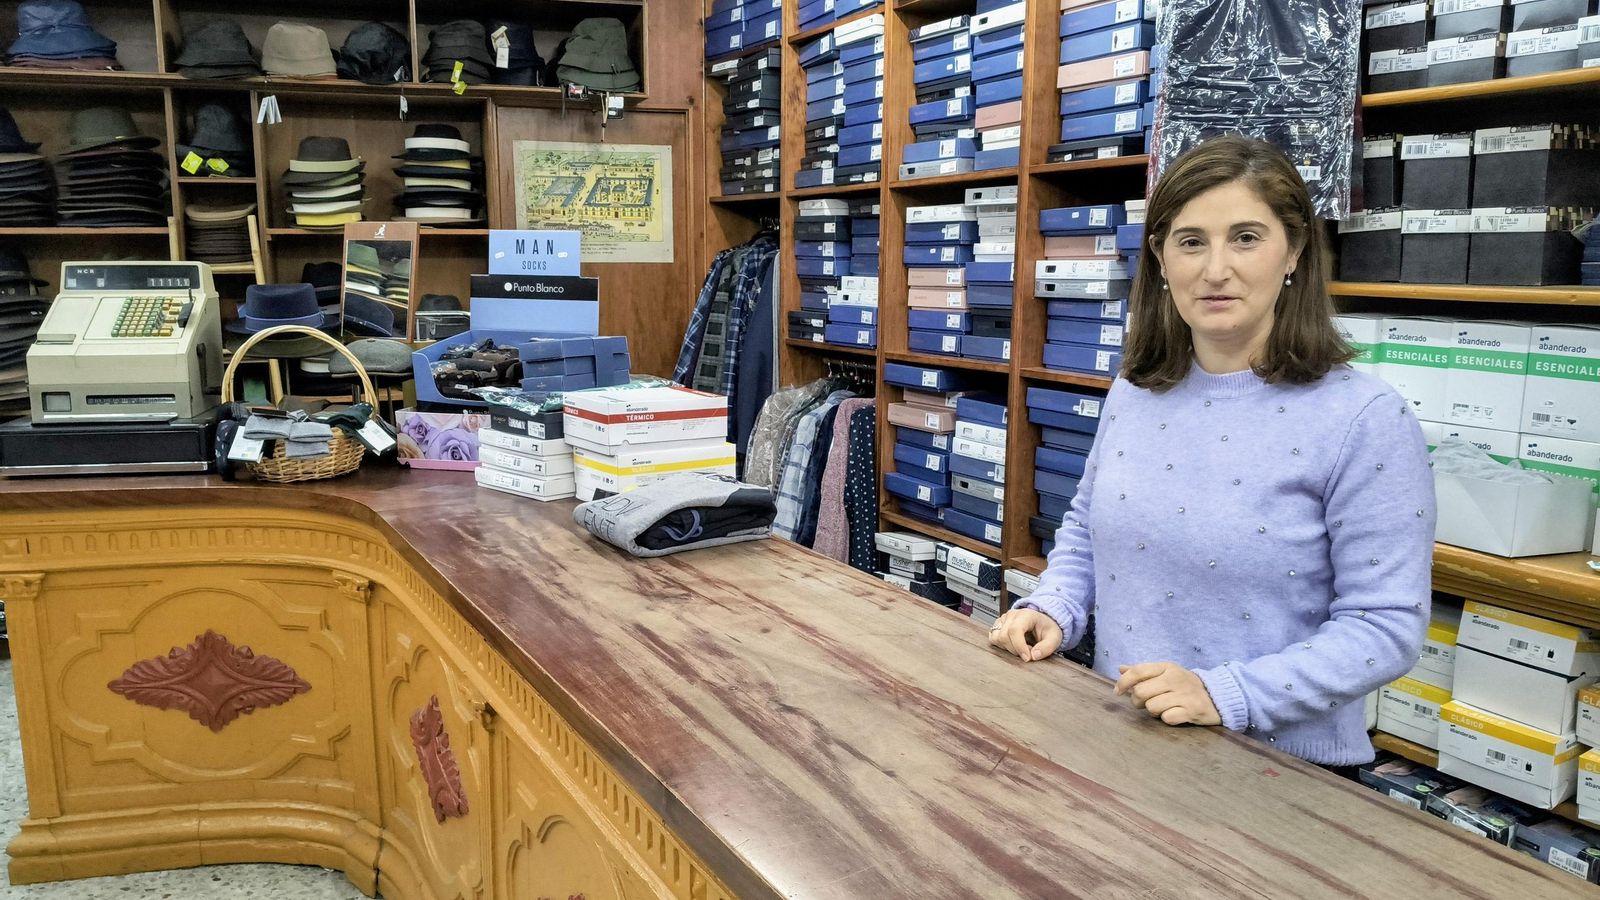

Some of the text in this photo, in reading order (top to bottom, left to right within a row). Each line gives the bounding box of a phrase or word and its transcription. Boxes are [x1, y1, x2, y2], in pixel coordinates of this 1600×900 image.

[515, 239, 554, 255] MAN
[522, 261, 547, 270] SOCKS
[513, 283, 564, 293] Punto Blanco
[1388, 333, 1427, 342] abanderado
[1458, 338, 1501, 347] abanderado
[1539, 343, 1587, 353] abanderado
[1386, 350, 1448, 363] ESENCIALES
[1455, 355, 1524, 369] ESENCIALES
[1527, 449, 1573, 463] abanderado
